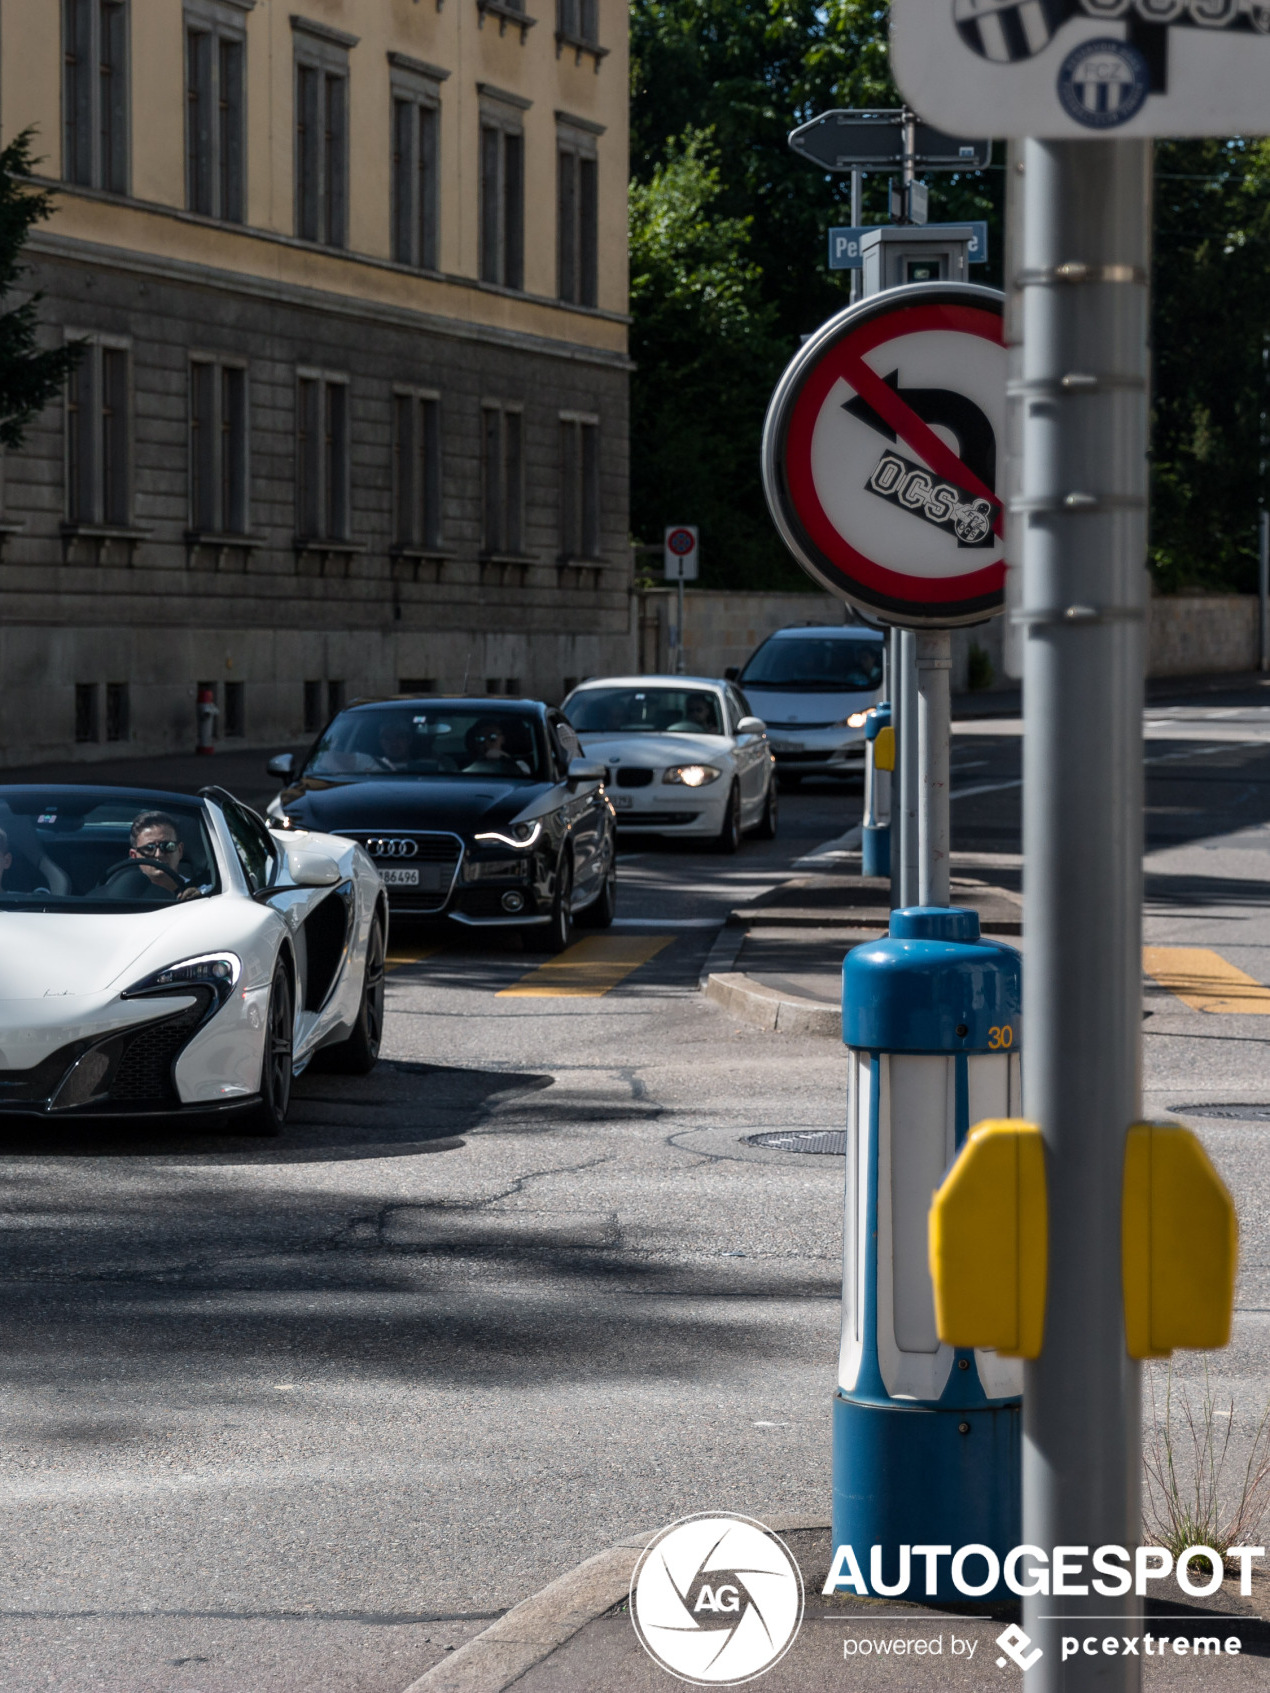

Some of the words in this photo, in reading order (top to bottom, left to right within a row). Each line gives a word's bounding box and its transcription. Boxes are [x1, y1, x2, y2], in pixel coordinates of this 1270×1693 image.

[1086, 62, 1121, 79] FCZ
[870, 456, 959, 523] OCS
[988, 1025, 1013, 1049] 30
